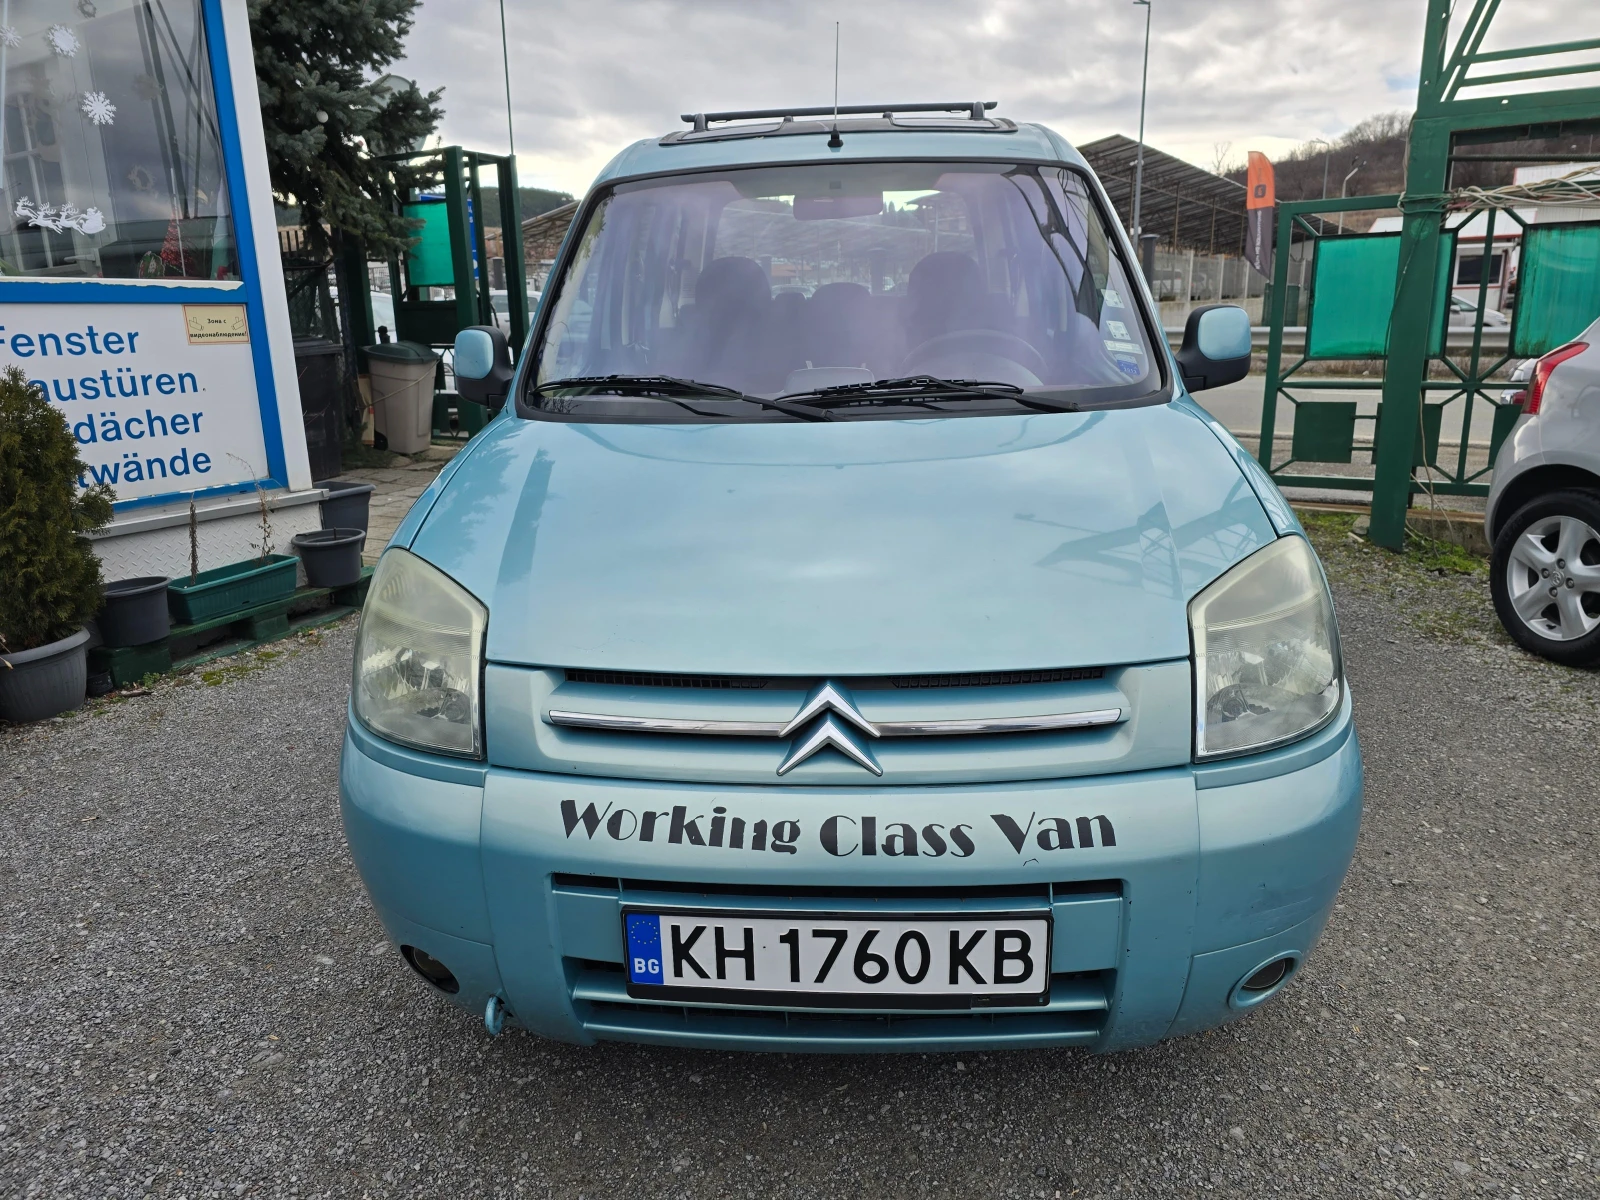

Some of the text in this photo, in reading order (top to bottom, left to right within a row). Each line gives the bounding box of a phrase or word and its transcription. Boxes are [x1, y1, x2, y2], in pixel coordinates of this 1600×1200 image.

[28, 367, 198, 402] austüren
[66, 409, 204, 444] dächer
[560, 799, 1117, 858] Working Class Van
[634, 957, 660, 975] BG
[670, 923, 1035, 986] KH 1760 KB
